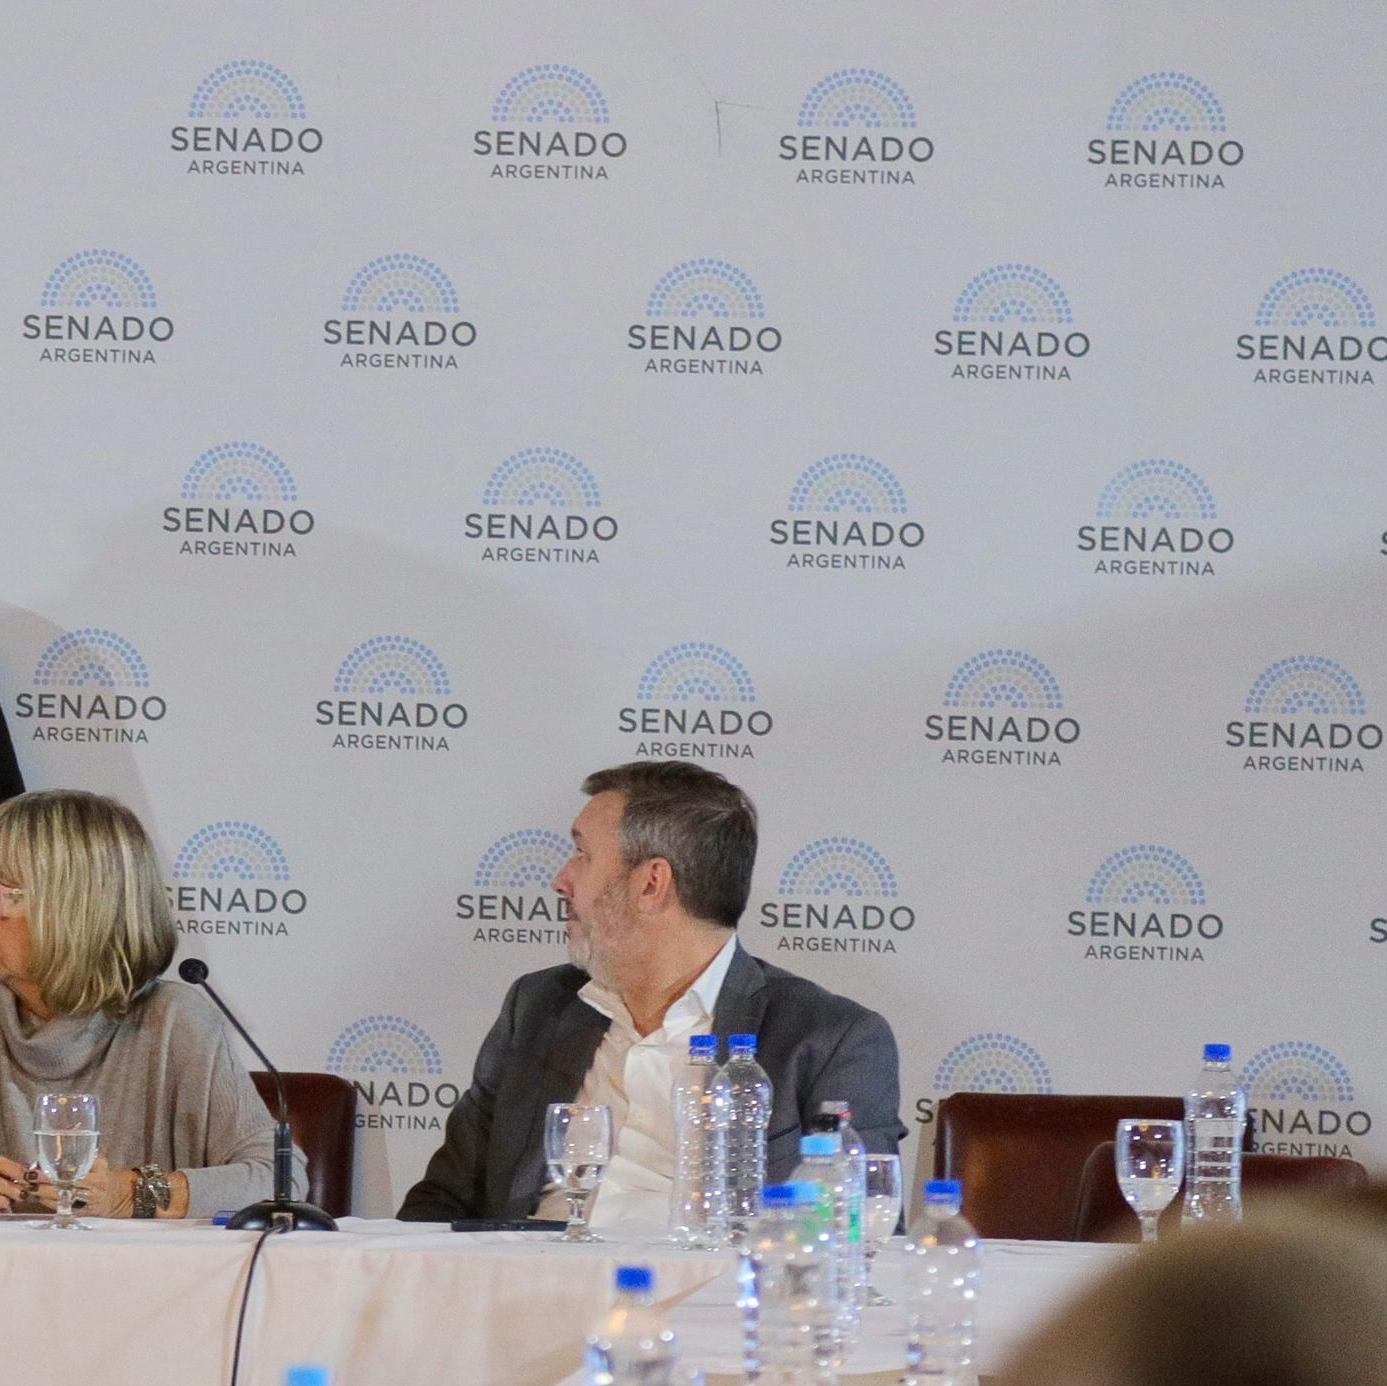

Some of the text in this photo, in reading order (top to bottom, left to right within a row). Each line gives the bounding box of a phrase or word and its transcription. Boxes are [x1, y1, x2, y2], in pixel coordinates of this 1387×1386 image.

[170, 125, 324, 154] SENADO
[472, 129, 628, 159] SENADO
[778, 134, 935, 163] SENADO
[1086, 138, 1245, 167] SENADO
[186, 159, 305, 176] ARGENTINA
[490, 163, 609, 180] ARGENTINA
[795, 168, 916, 185] ARGENTINA
[1104, 172, 1225, 189] ARGENTINA
[22, 313, 175, 343] SENADO
[323, 319, 478, 348] SENADO
[627, 323, 783, 353] SENADO
[933, 329, 1091, 359] SENADO
[39, 347, 156, 364] ARGENTINA
[1235, 333, 1387, 363] SENADO
[339, 352, 459, 369] ARGENTINA
[644, 357, 764, 375] ARGENTINA
[950, 363, 1072, 381] ARGENTINA
[1252, 368, 1375, 385] ARGENTINA
[162, 506, 315, 536] SENADO
[464, 512, 619, 542] SENADO
[769, 518, 926, 548] SENADO
[1076, 525, 1235, 554] SENADO
[178, 540, 297, 557] ARGENTINA
[481, 546, 600, 564] ARGENTINA
[786, 552, 907, 570] ARGENTINA
[1093, 559, 1216, 576] ARGENTINA
[15, 692, 167, 722] SENADO
[315, 699, 469, 730] SENADO
[618, 707, 774, 737] SENADO
[924, 714, 1081, 745] SENADO
[32, 726, 149, 744] ARGENTINA
[331, 734, 450, 752] ARGENTINA
[1225, 720, 1384, 751] SENADO
[636, 741, 755, 759] ARGENTINA
[941, 748, 1062, 767] ARGENTINA
[1242, 755, 1365, 773] ARGENTINA
[455, 893, 571, 923] SENAD
[759, 902, 916, 932] SENADO
[175, 919, 289, 937] ARGENTINA
[1066, 910, 1224, 940] SENADO
[472, 927, 572, 945] ARGENTI
[777, 935, 897, 954] ARGENTINA
[1083, 944, 1205, 962] ARGENTINA
[352, 1079, 461, 1109] NADO
[352, 1113, 442, 1131] GENTINA
[1247, 1107, 1373, 1137] NADO
[1251, 1140, 1354, 1158] GENTINA
